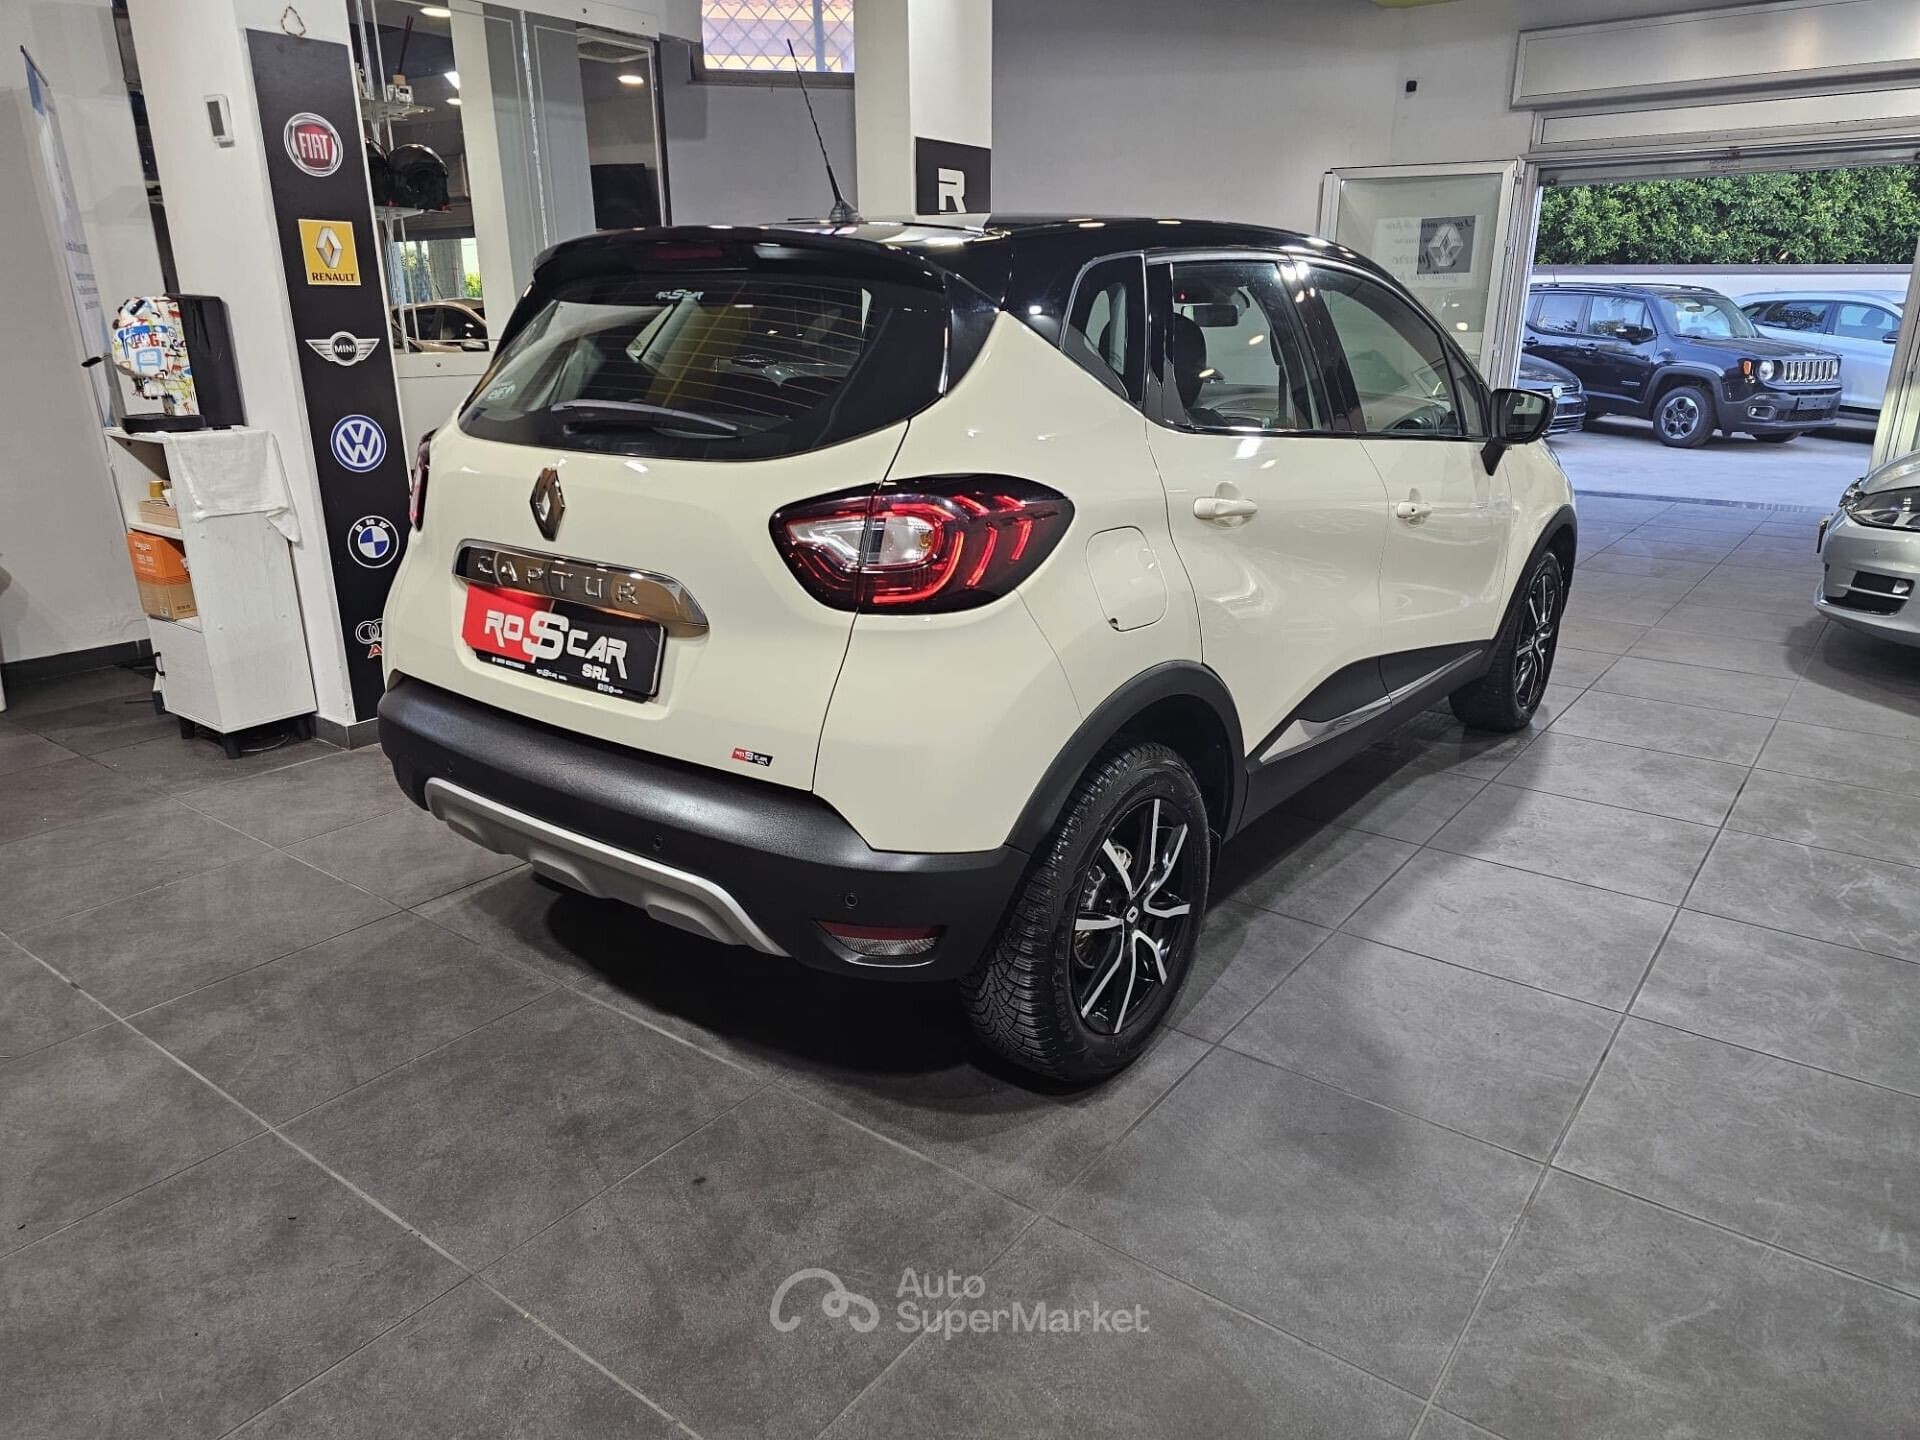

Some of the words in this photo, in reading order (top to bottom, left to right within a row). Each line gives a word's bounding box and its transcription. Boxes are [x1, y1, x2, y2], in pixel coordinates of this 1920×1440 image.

[297, 132, 330, 160] FIAT
[311, 272, 356, 282] RENAULT
[333, 344, 356, 353] MINI
[354, 518, 389, 533] BMW
[477, 554, 639, 606] CAPTUR
[581, 662, 611, 682] SRL
